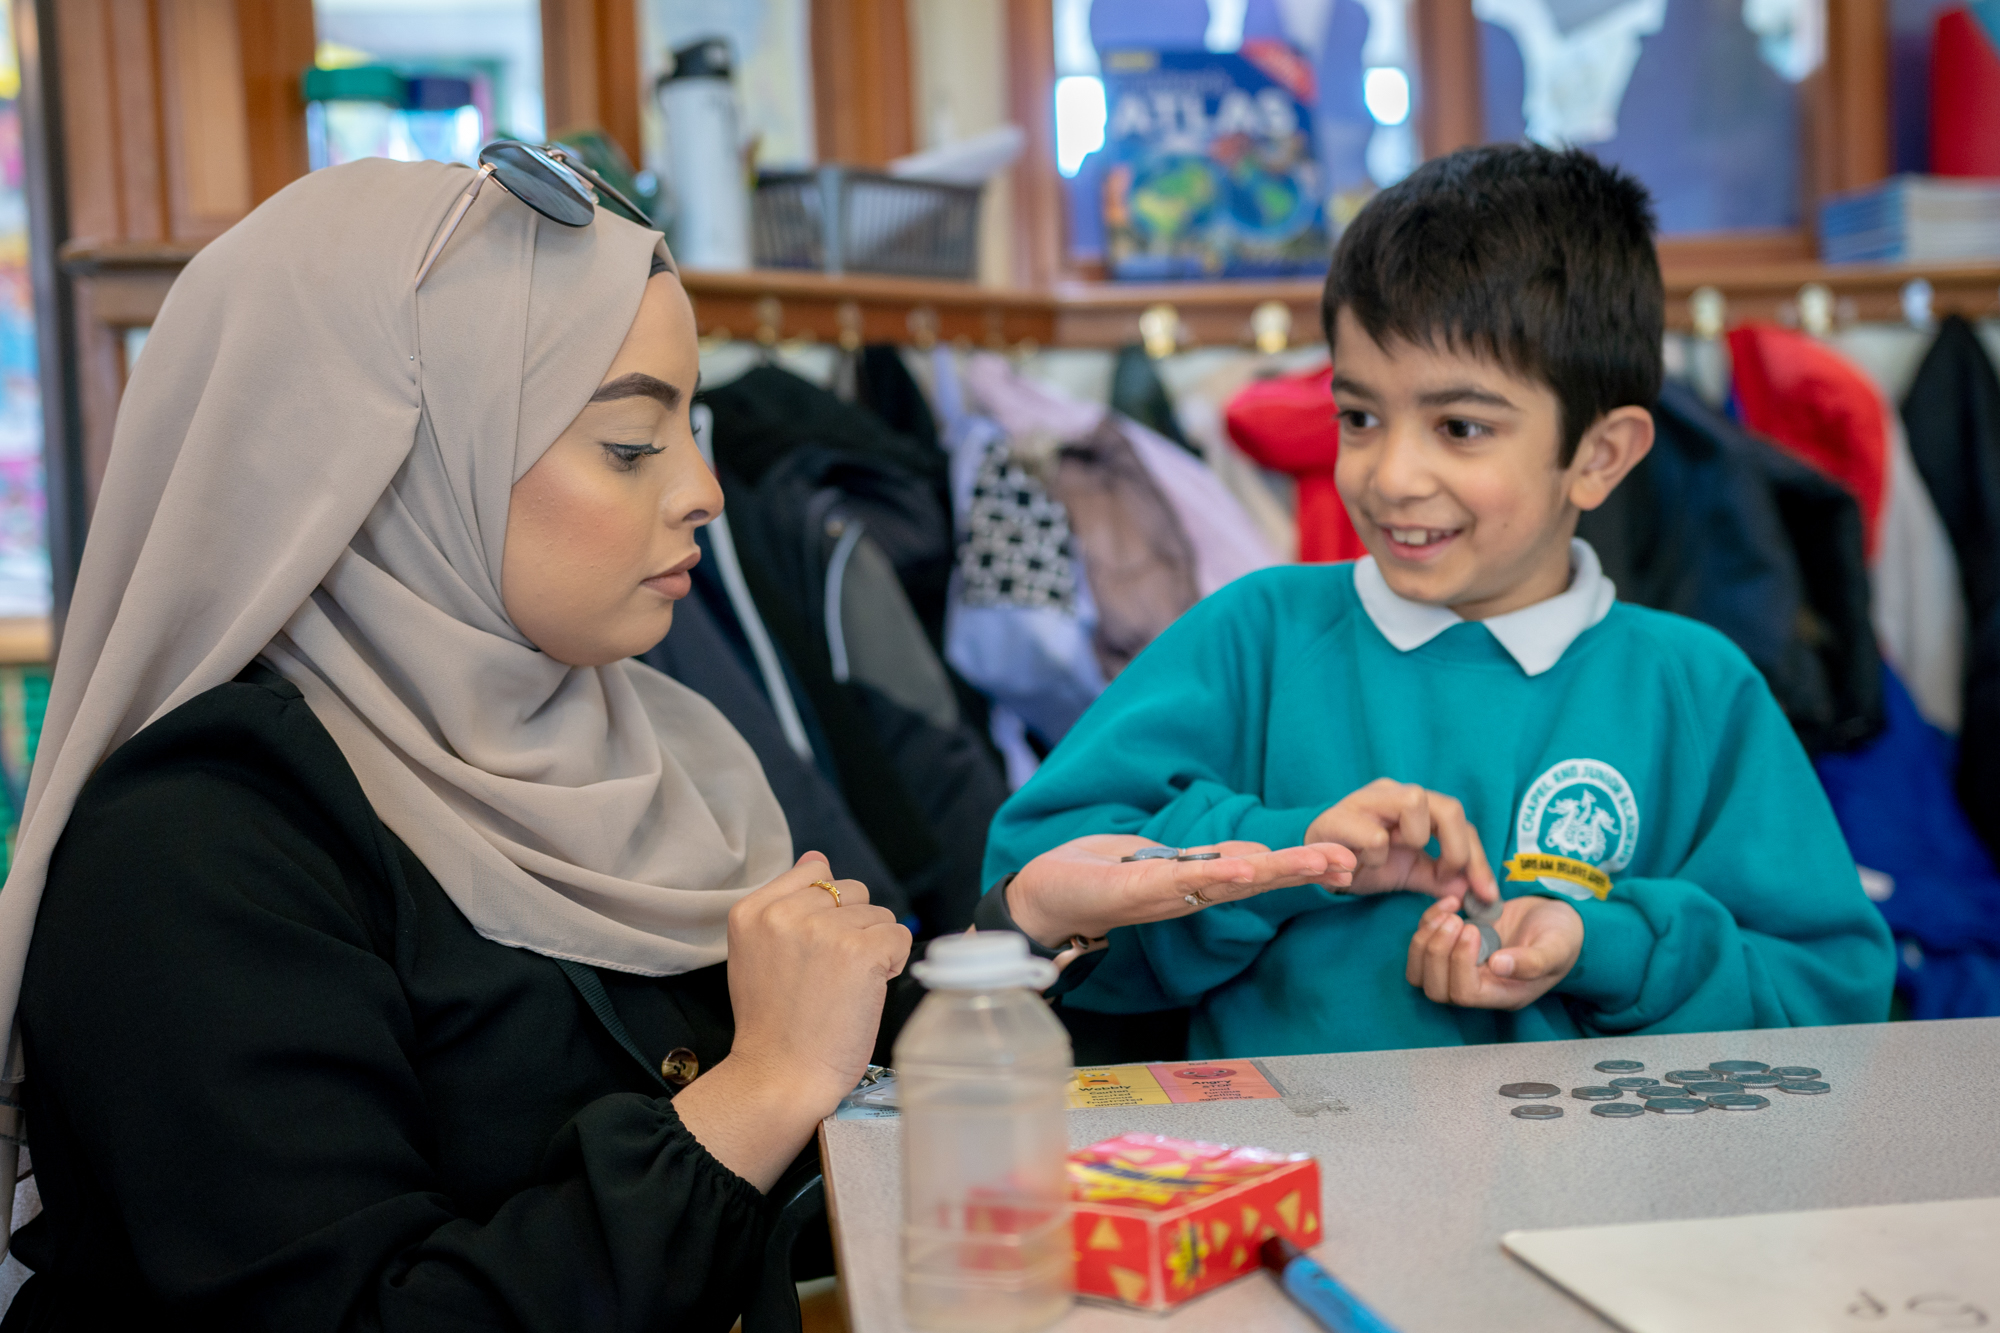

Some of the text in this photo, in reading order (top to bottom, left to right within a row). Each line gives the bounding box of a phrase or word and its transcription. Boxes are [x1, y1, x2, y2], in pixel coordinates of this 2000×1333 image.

[1111, 85, 1298, 138] ATLAS
[1521, 780, 1553, 832] CHAPEL
[1581, 765, 1624, 795] JUNIOR
[1520, 858, 1554, 871] DREAM
